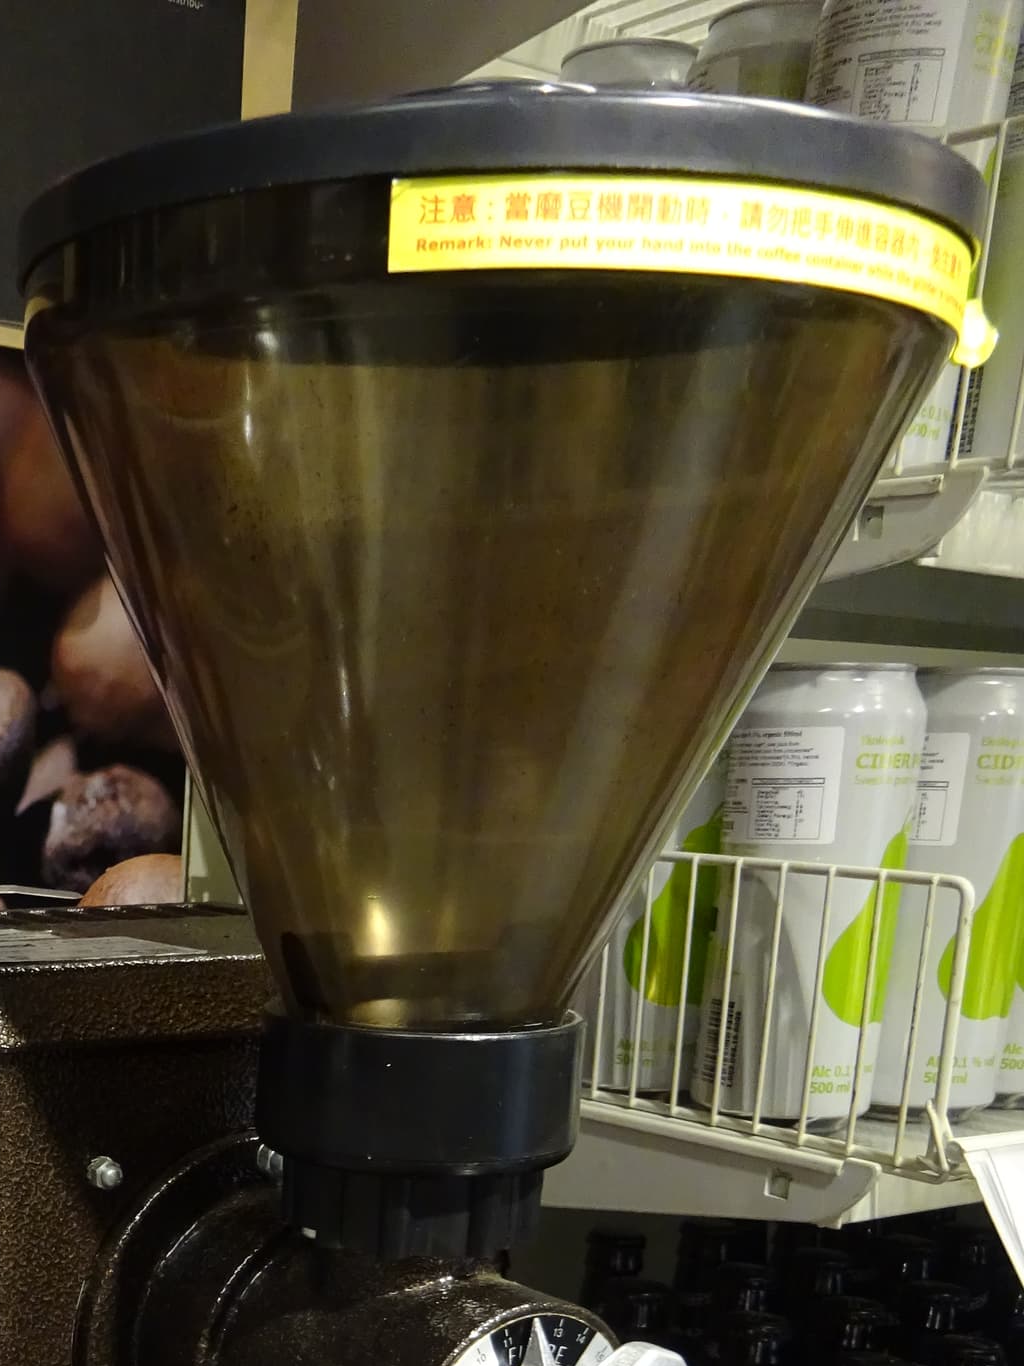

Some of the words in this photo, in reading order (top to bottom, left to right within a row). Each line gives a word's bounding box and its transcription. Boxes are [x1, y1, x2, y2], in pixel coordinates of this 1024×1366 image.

[416, 235, 492, 253] Remark:
[499, 235, 552, 249] Never
[560, 236, 589, 252] put
[596, 239, 635, 253] your
[642, 237, 684, 251] hand
[809, 1081, 834, 1094] 500
